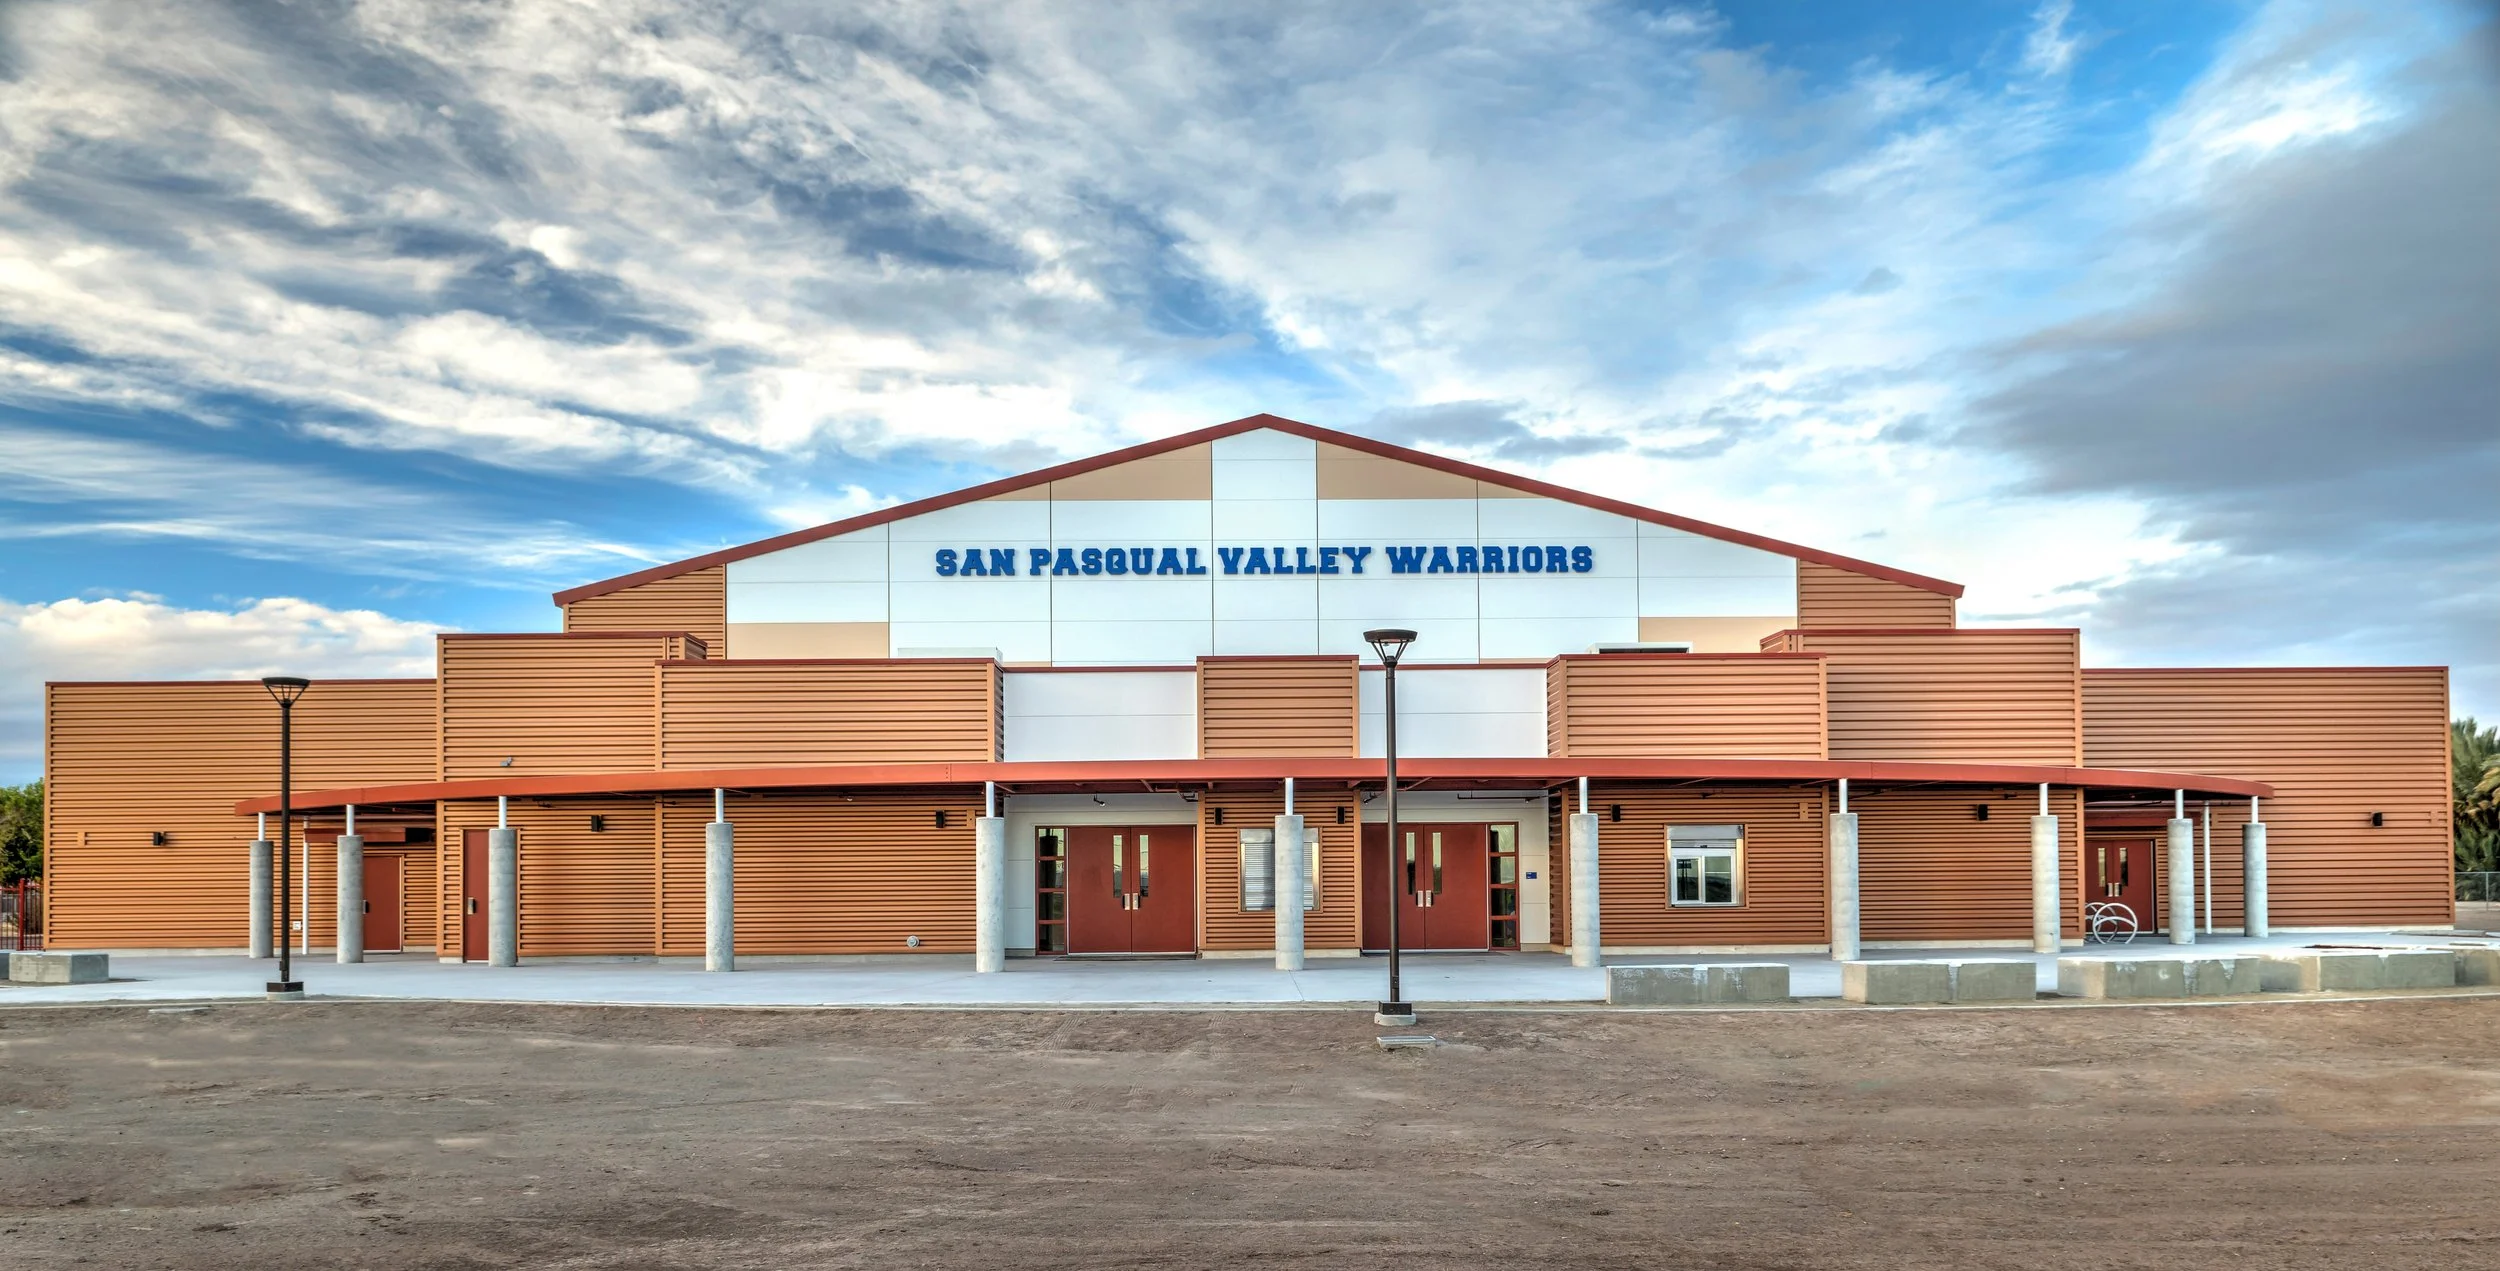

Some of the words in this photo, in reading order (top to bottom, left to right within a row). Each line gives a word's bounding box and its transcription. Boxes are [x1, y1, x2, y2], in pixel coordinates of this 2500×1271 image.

[935, 548, 1016, 576] SAN
[1029, 547, 1207, 575] PASQUAL
[1217, 546, 1372, 574] VALLEY
[1385, 545, 1593, 573] WARRIORS
